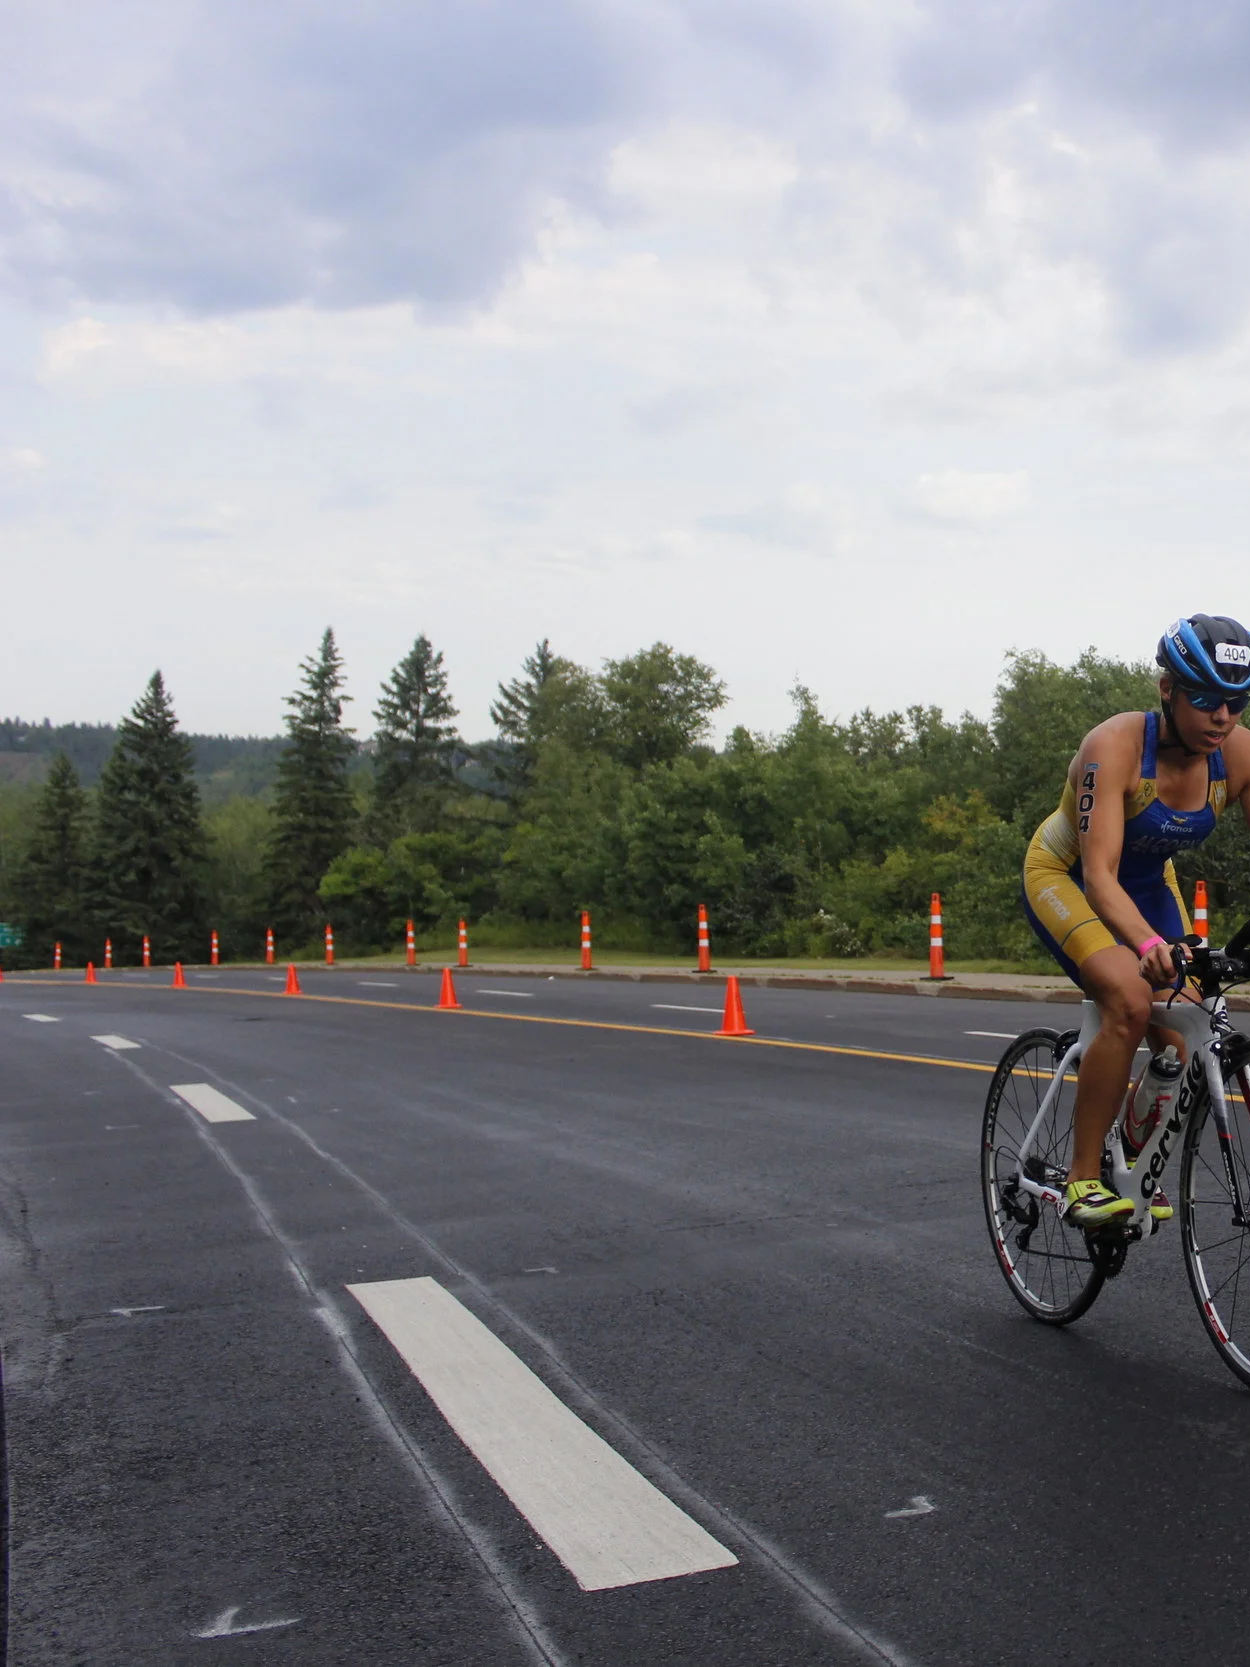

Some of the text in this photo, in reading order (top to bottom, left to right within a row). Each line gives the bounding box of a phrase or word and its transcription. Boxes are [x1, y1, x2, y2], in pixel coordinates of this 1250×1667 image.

[1173, 634, 1187, 655] GIRO
[1224, 647, 1246, 662] 404
[1078, 770, 1096, 833] 404
[1161, 820, 1193, 833] Kronos
[1037, 884, 1071, 921] Kronos
